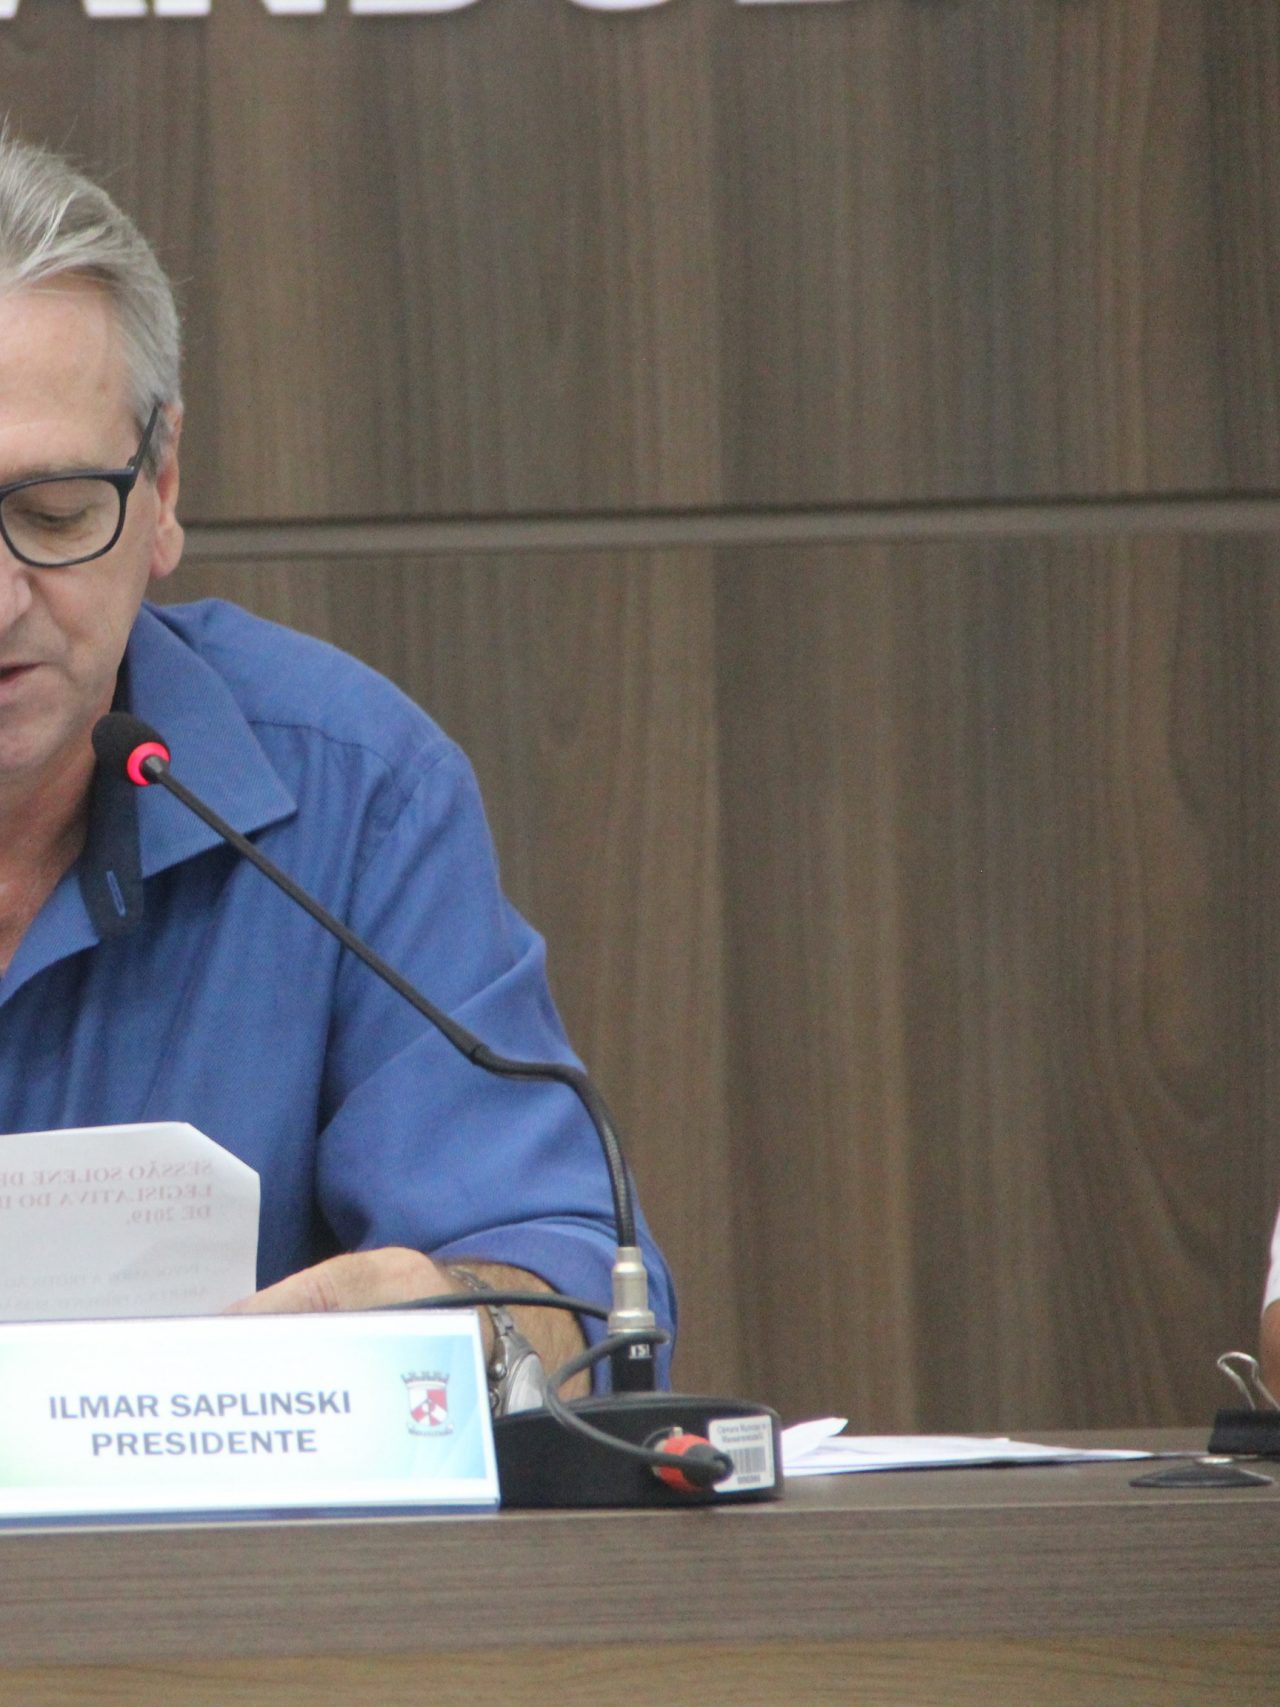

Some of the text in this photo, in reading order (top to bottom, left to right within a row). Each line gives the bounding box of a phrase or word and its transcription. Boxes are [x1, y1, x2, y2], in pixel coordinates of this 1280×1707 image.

[49, 1390, 351, 1419] ILMAR SAPLINSKI
[91, 1429, 317, 1456] PRESIDENTE
